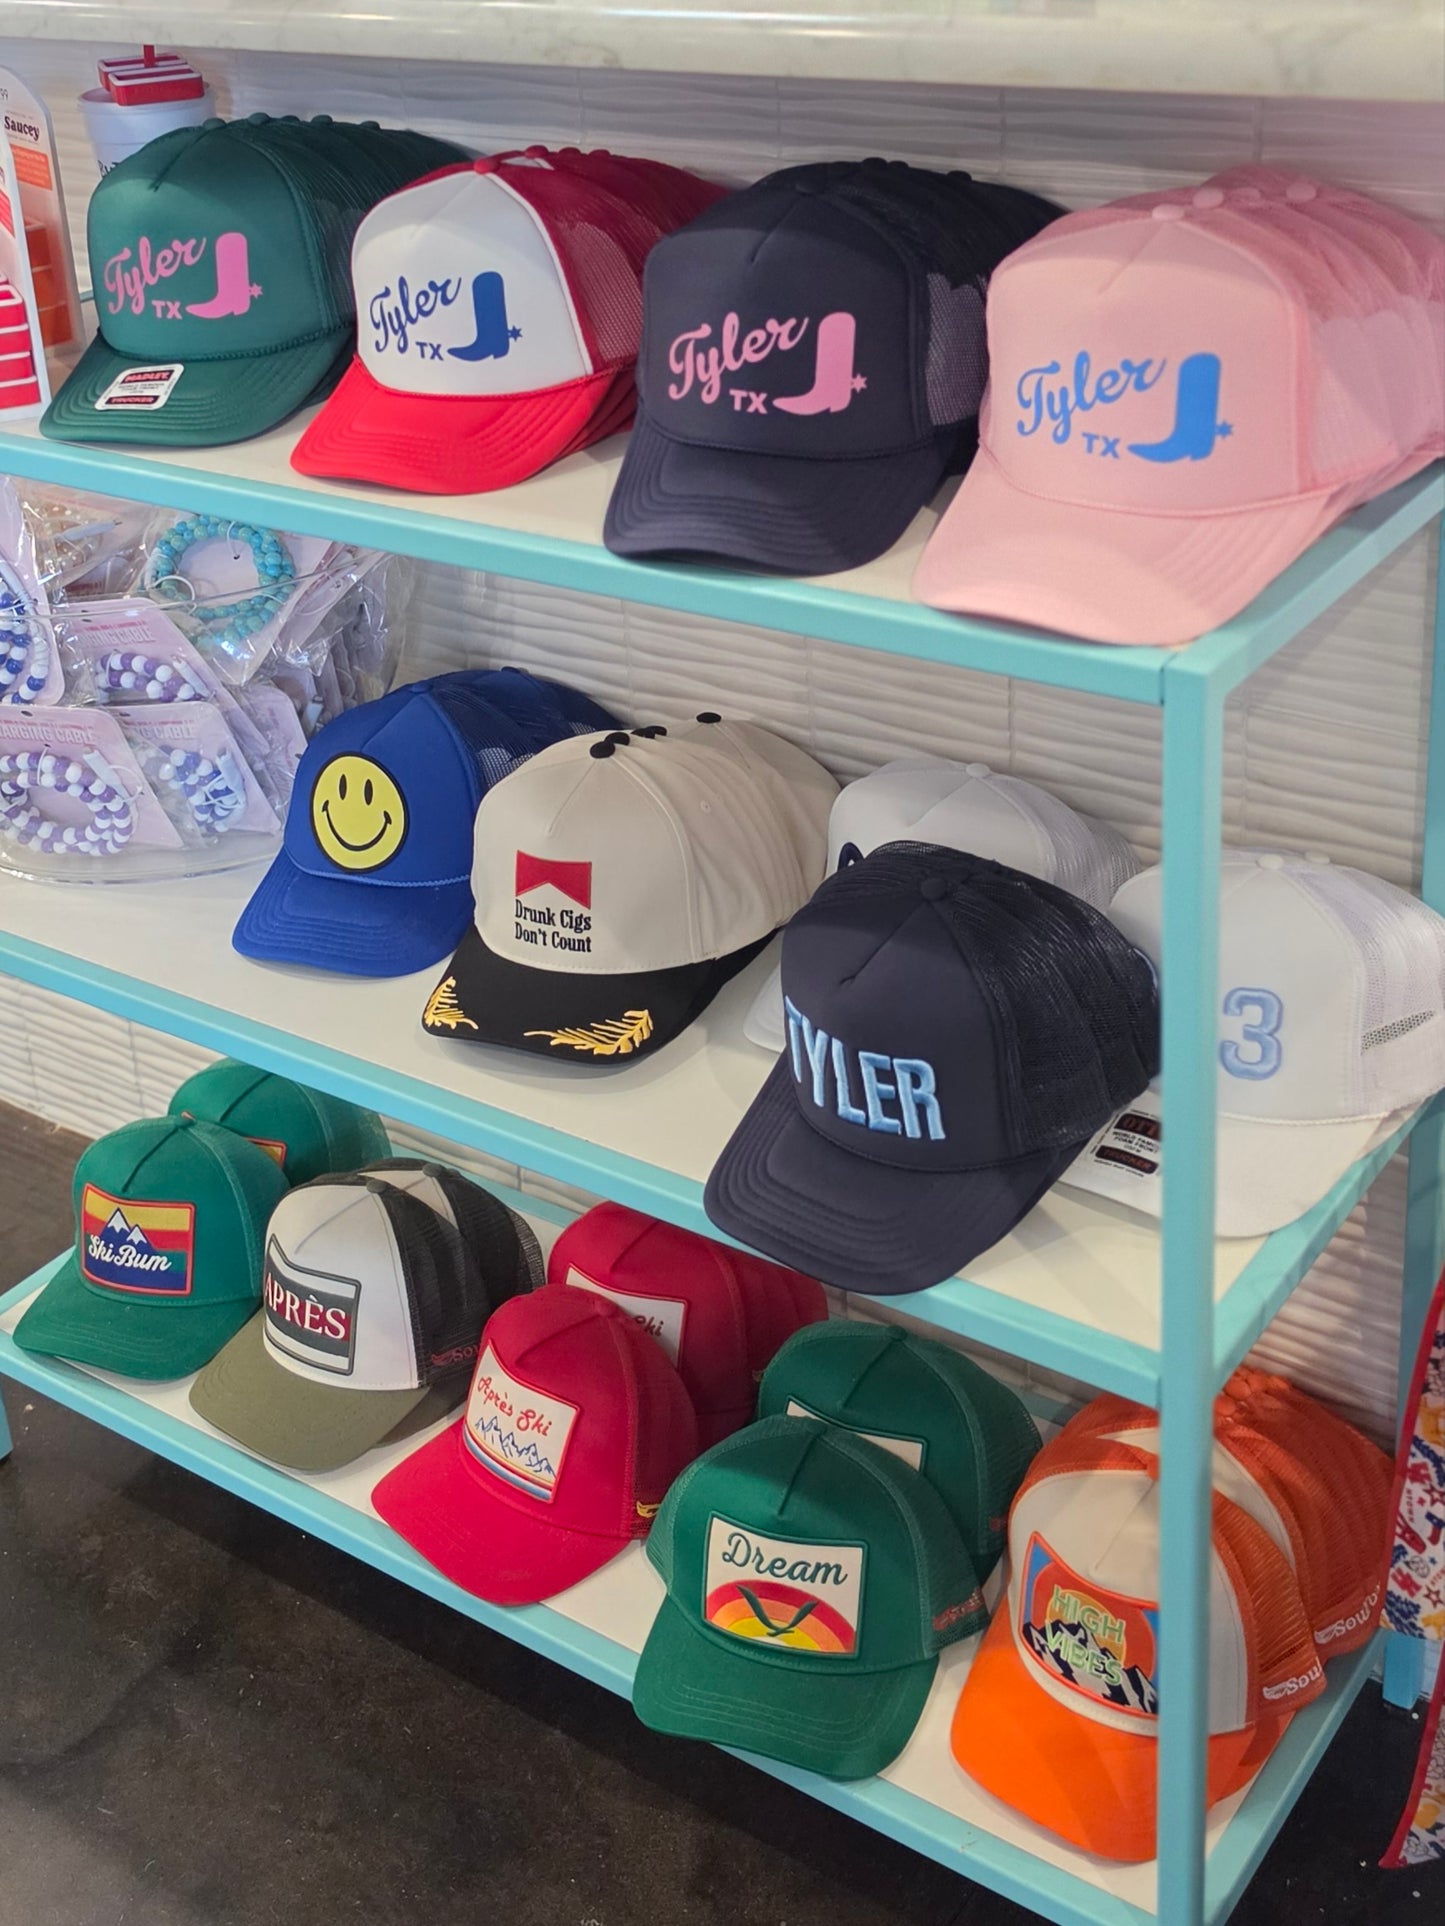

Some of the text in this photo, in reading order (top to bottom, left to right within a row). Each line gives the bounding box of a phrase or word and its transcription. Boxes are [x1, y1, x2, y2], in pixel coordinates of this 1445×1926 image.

[4, 115, 40, 142] Saucey
[104, 236, 207, 315] Tyler
[151, 300, 183, 320] TX
[369, 275, 462, 354] Tyler
[415, 341, 444, 361] TX
[668, 311, 809, 404] Tyler
[729, 389, 768, 414] TX
[1016, 350, 1167, 444] Tyler
[1082, 432, 1121, 460] TX
[0, 726, 53, 741] ARGING
[515, 898, 592, 934] Drunk Cigs
[515, 921, 592, 953] Don't Count
[784, 994, 947, 1140] TYLER
[88, 1234, 172, 1272] Ski Bum
[265, 1271, 346, 1340] APRÈS
[477, 1377, 552, 1436] Après Ski
[722, 1532, 848, 1586] Dream
[1053, 1585, 1126, 1645] HIGH
[1045, 1620, 1122, 1686] VIBES
